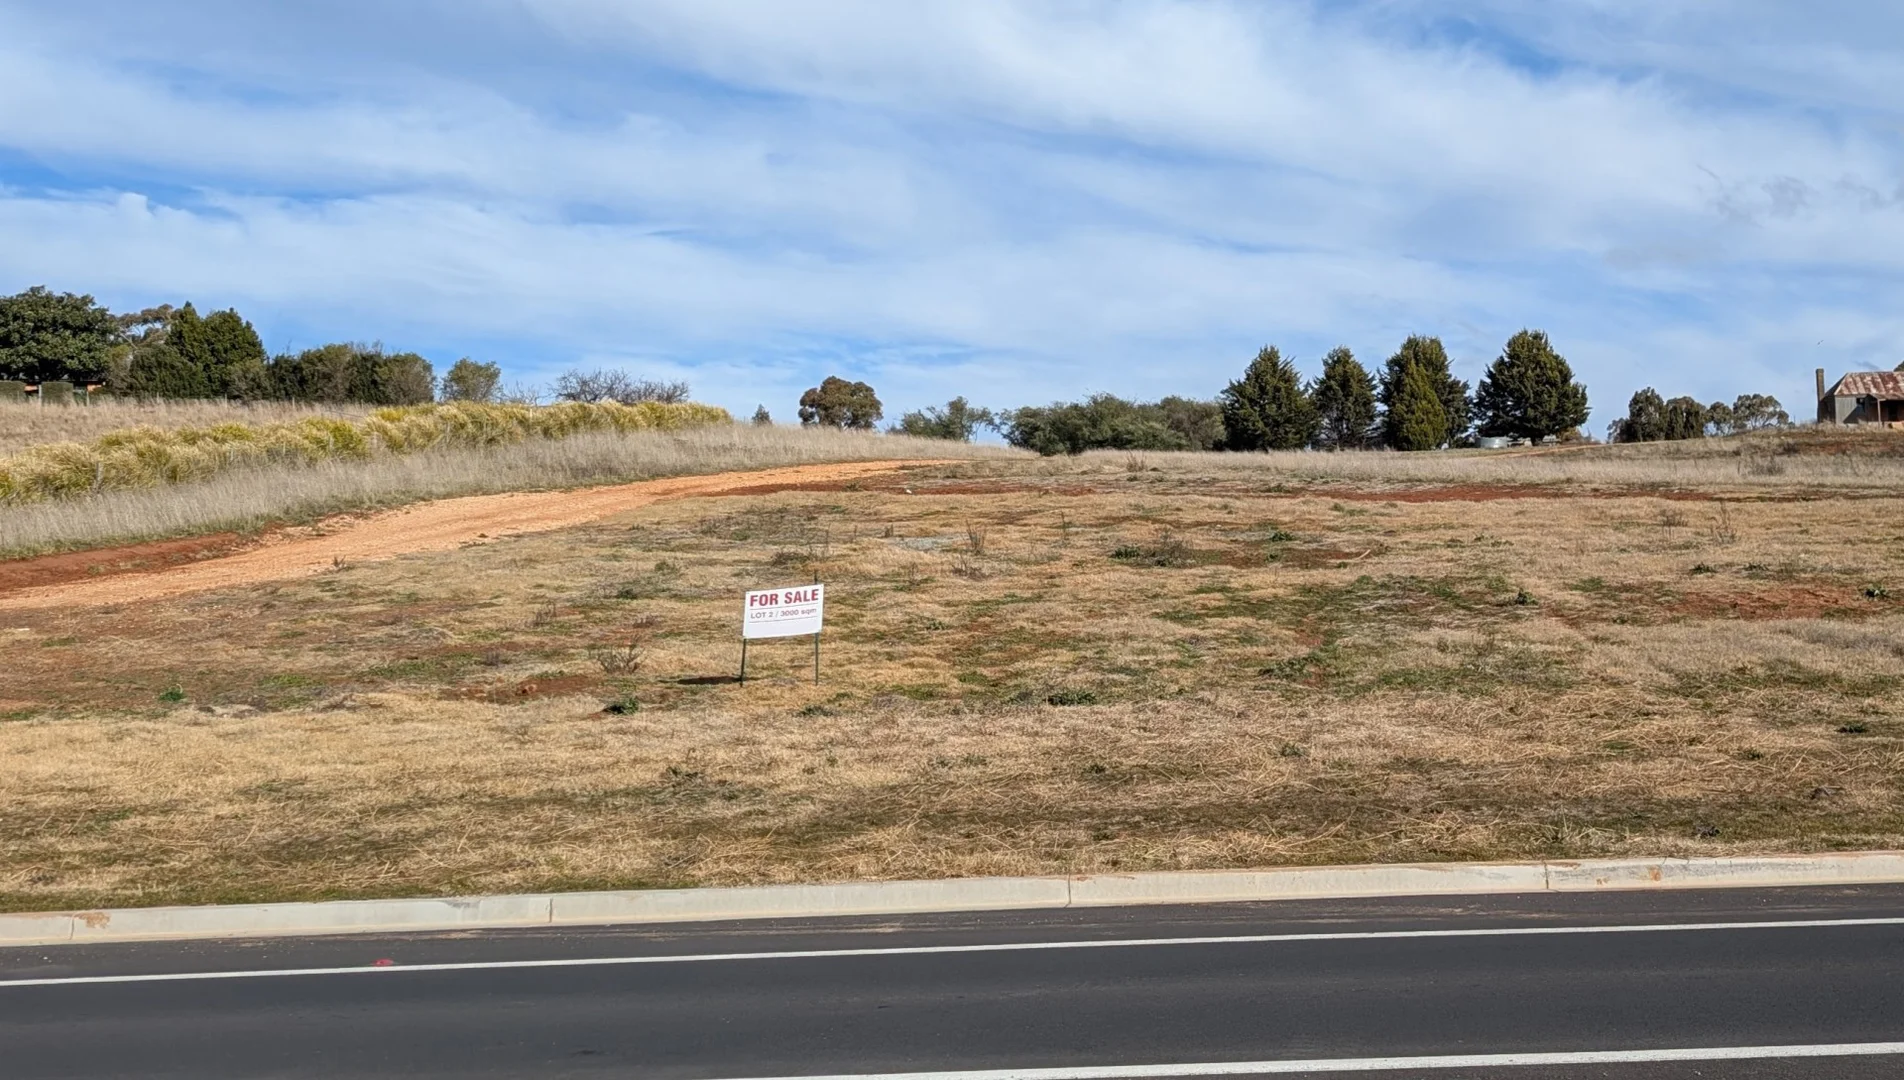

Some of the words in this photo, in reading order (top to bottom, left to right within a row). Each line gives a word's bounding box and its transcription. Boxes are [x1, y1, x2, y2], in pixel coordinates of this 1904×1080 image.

[750, 594, 778, 607] FOR
[784, 589, 819, 604] SALE
[780, 609, 799, 617] 3000
